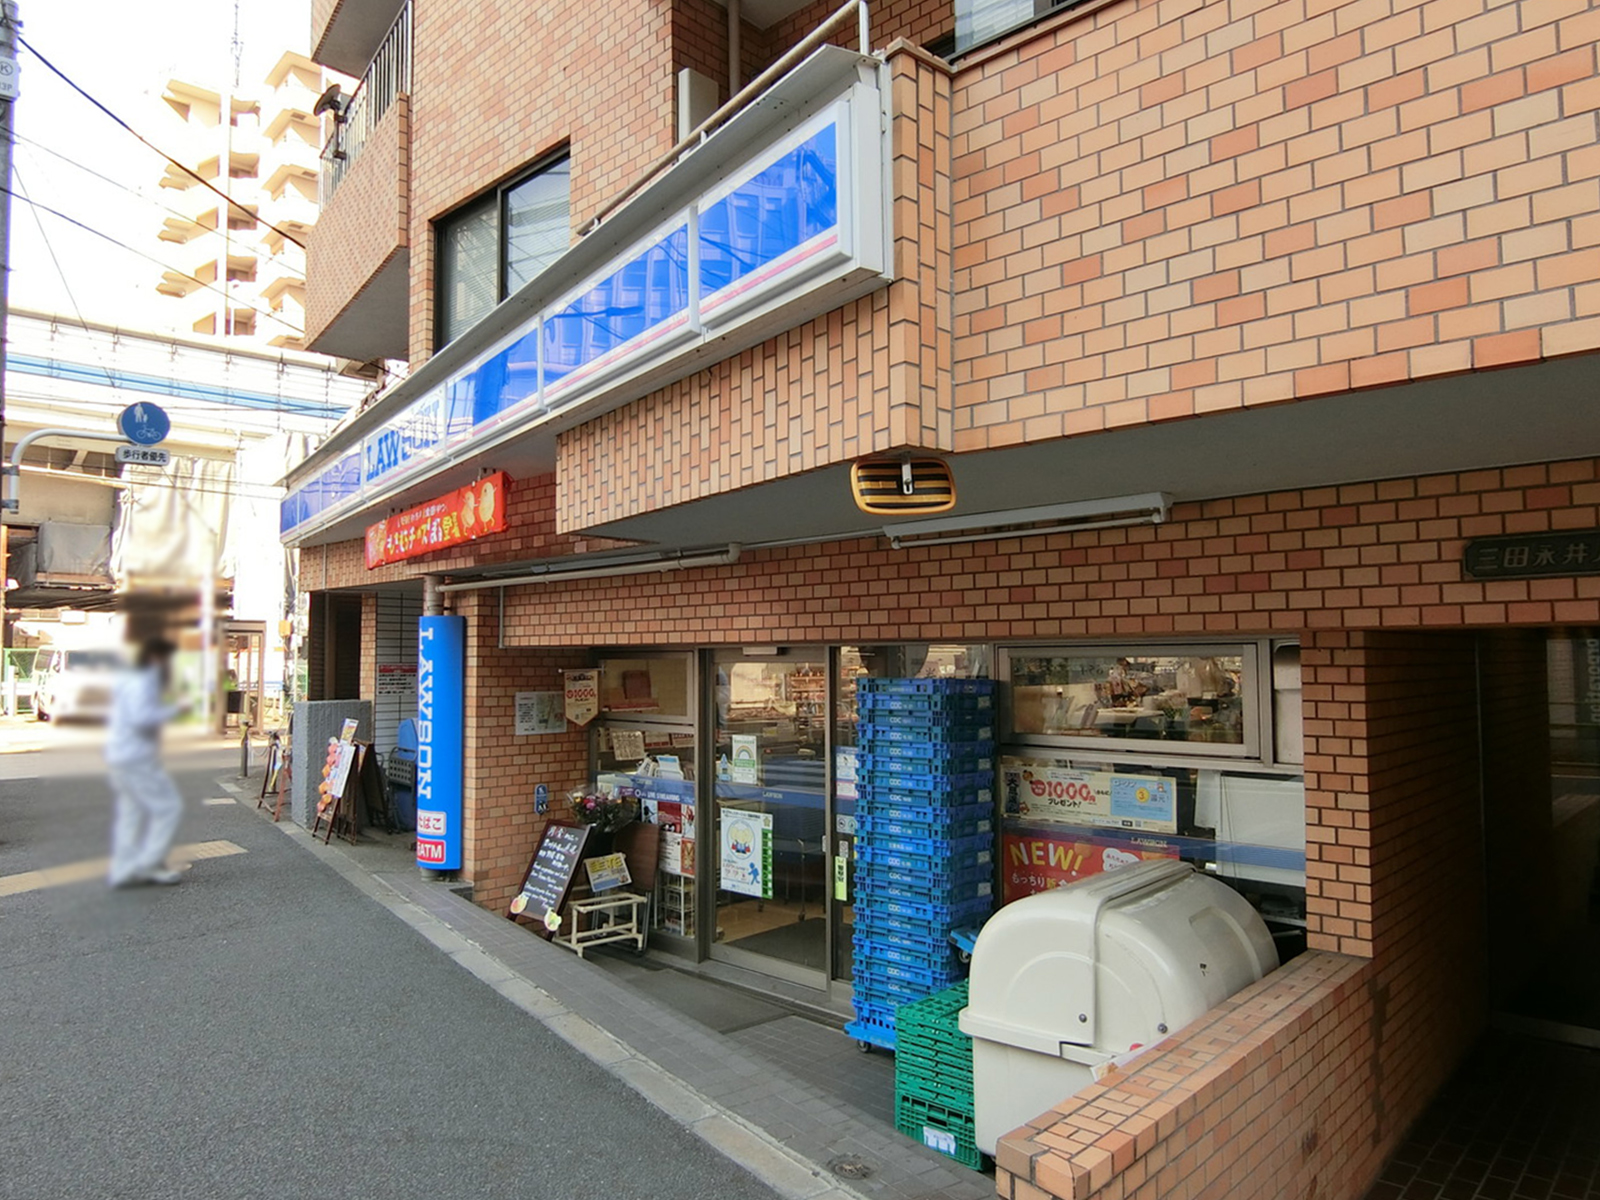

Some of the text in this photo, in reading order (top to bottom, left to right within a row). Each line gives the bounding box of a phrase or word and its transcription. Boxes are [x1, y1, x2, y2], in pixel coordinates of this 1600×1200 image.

[123, 449, 167, 463] 歩行者優先
[1474, 543, 1600, 569] 三田永井
[418, 628, 433, 799] LAWSON
[418, 842, 442, 858] ATM
[1009, 842, 1083, 876] NEW!
